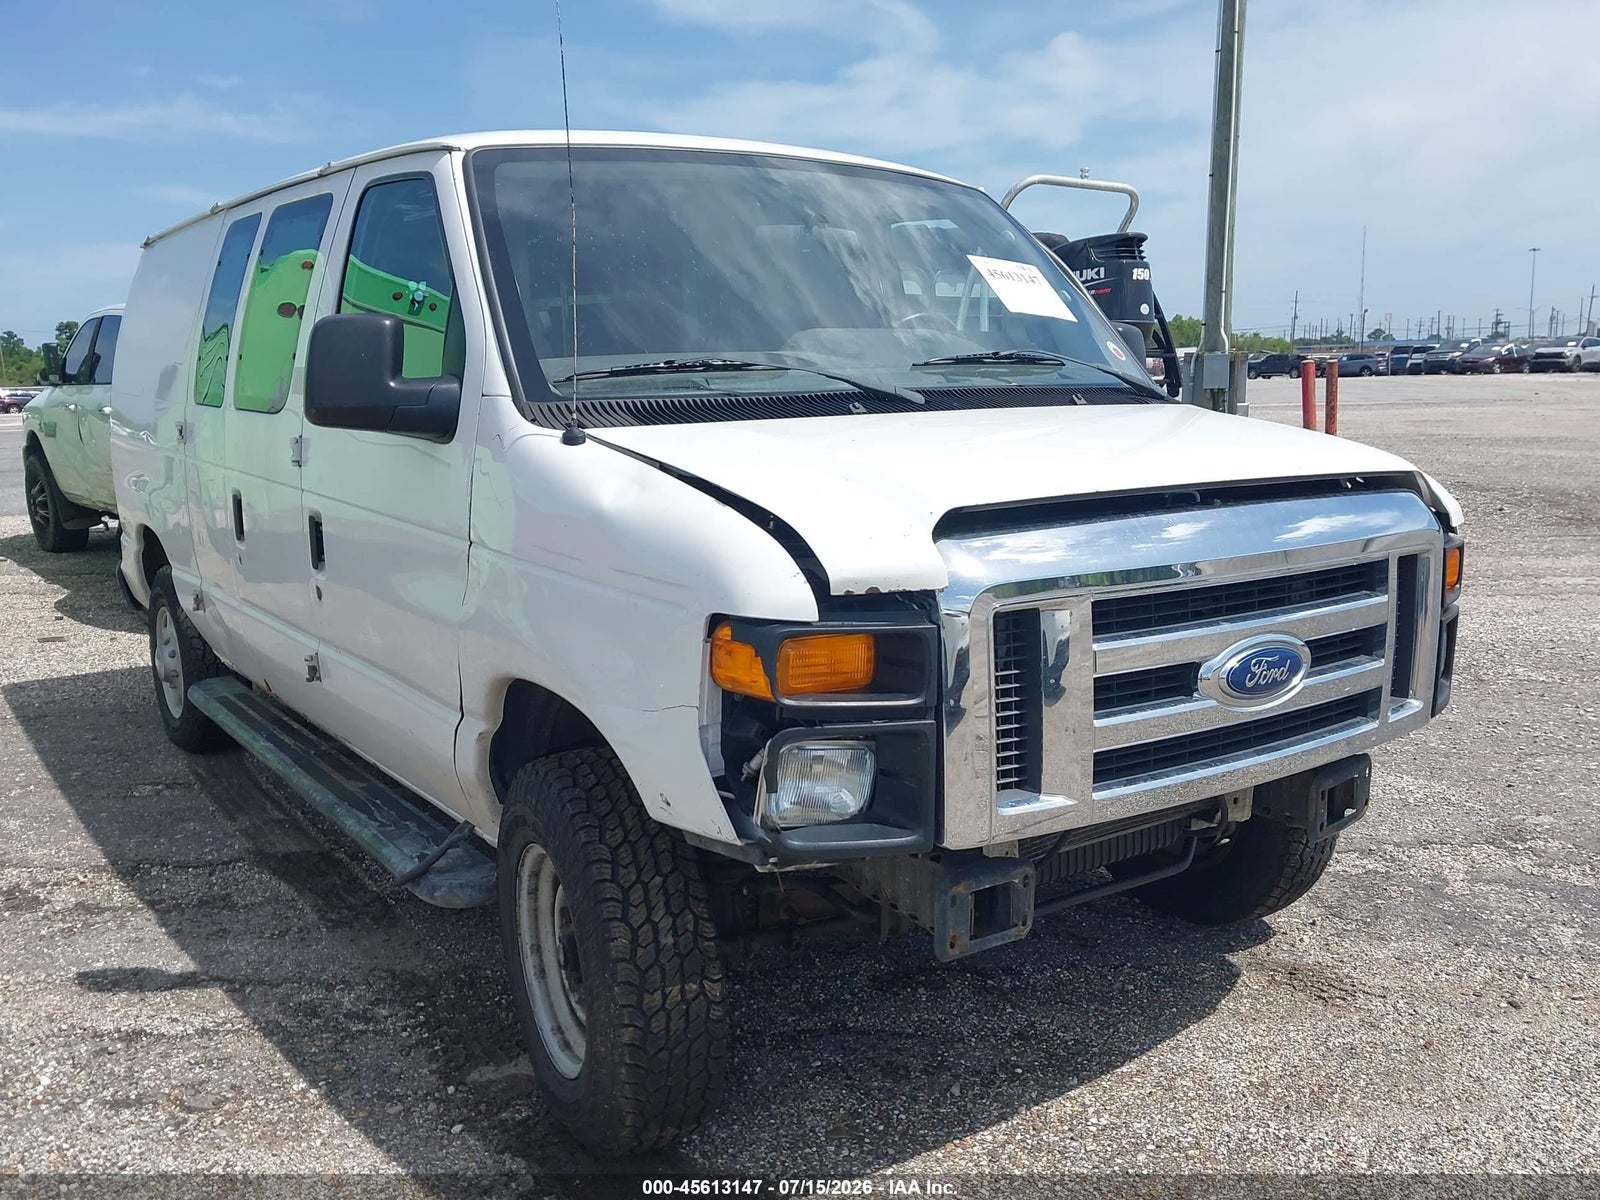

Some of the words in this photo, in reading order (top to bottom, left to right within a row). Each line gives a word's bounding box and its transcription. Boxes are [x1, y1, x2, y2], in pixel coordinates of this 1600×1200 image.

[987, 268, 1042, 286] 45613147
[1073, 266, 1105, 281] UKI
[1132, 267, 1150, 281] 150
[1245, 655, 1291, 688] Ford
